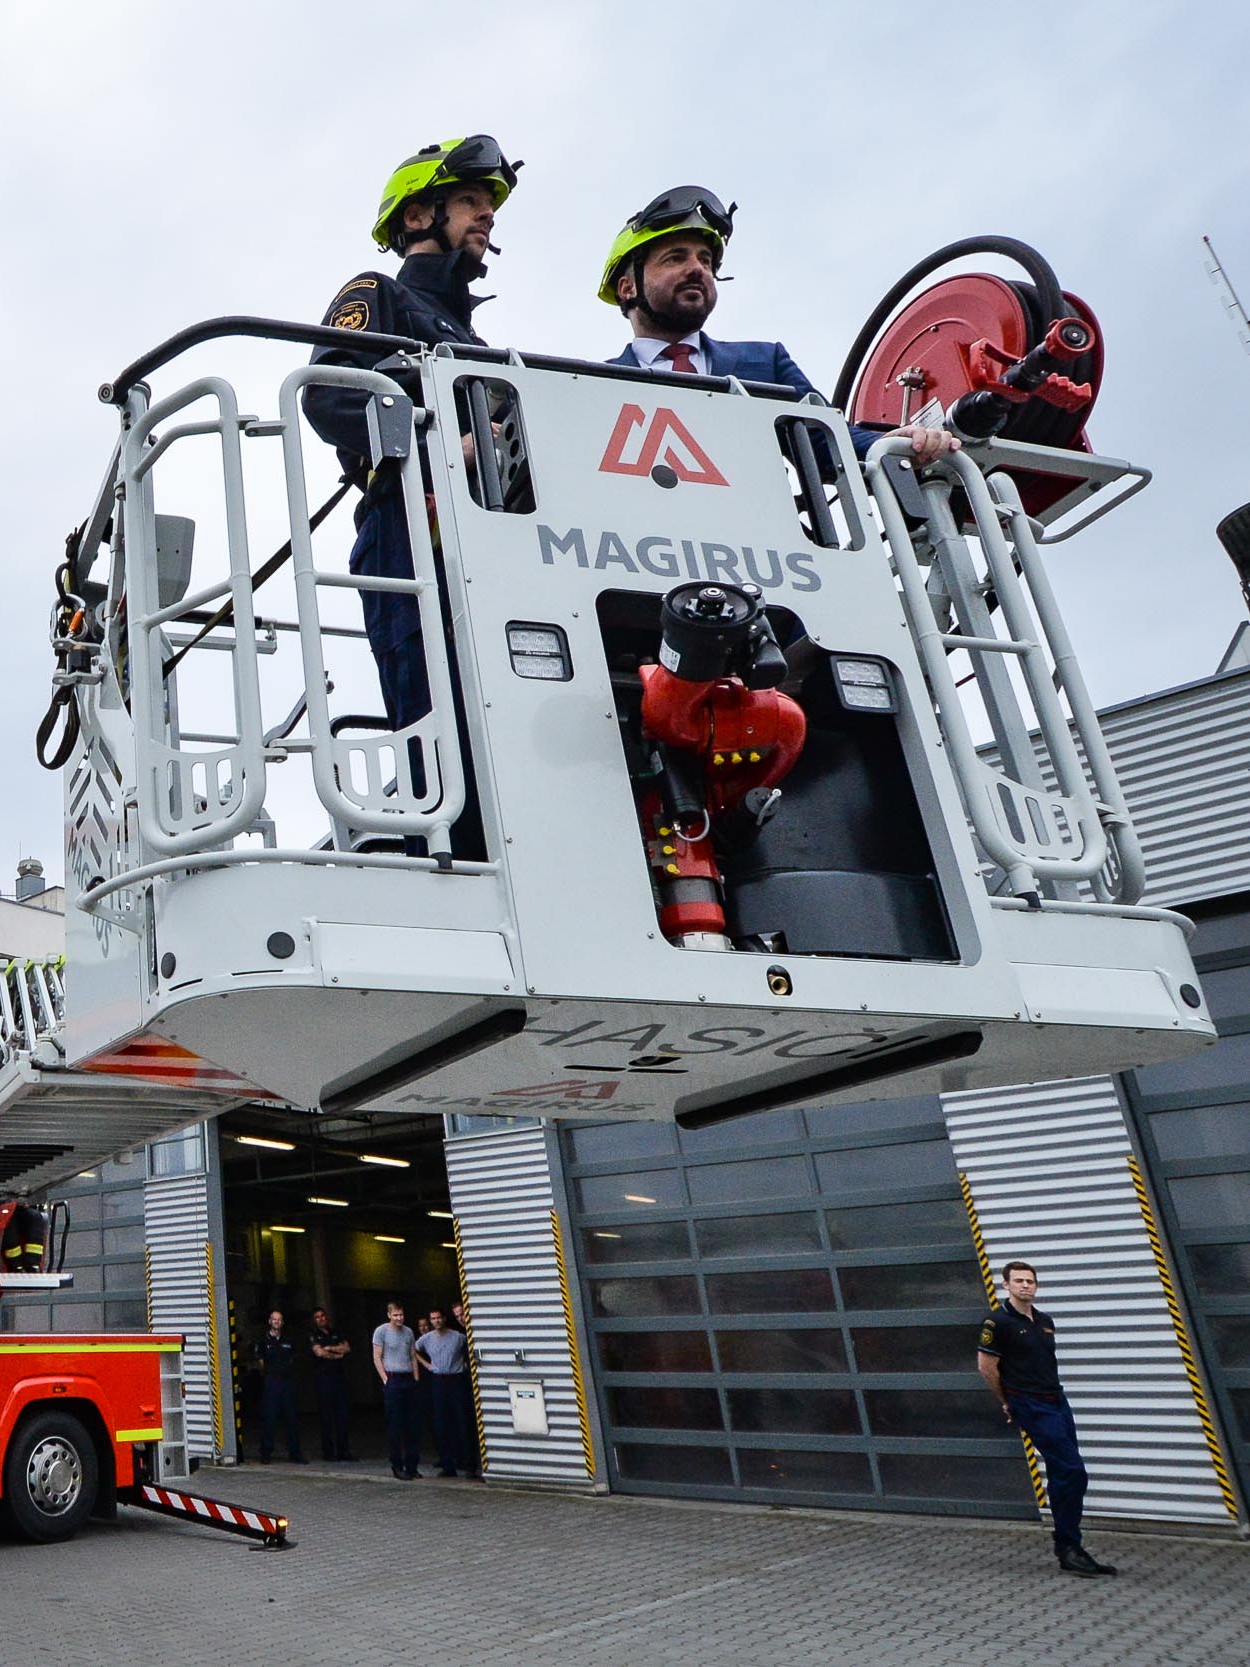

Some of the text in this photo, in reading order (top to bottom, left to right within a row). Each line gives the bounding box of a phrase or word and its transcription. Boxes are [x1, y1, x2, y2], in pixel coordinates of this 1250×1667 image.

[536, 524, 822, 593] MAGIRUS
[67, 825, 112, 959] MAGUS
[394, 1093, 656, 1112] MAGIRUS
